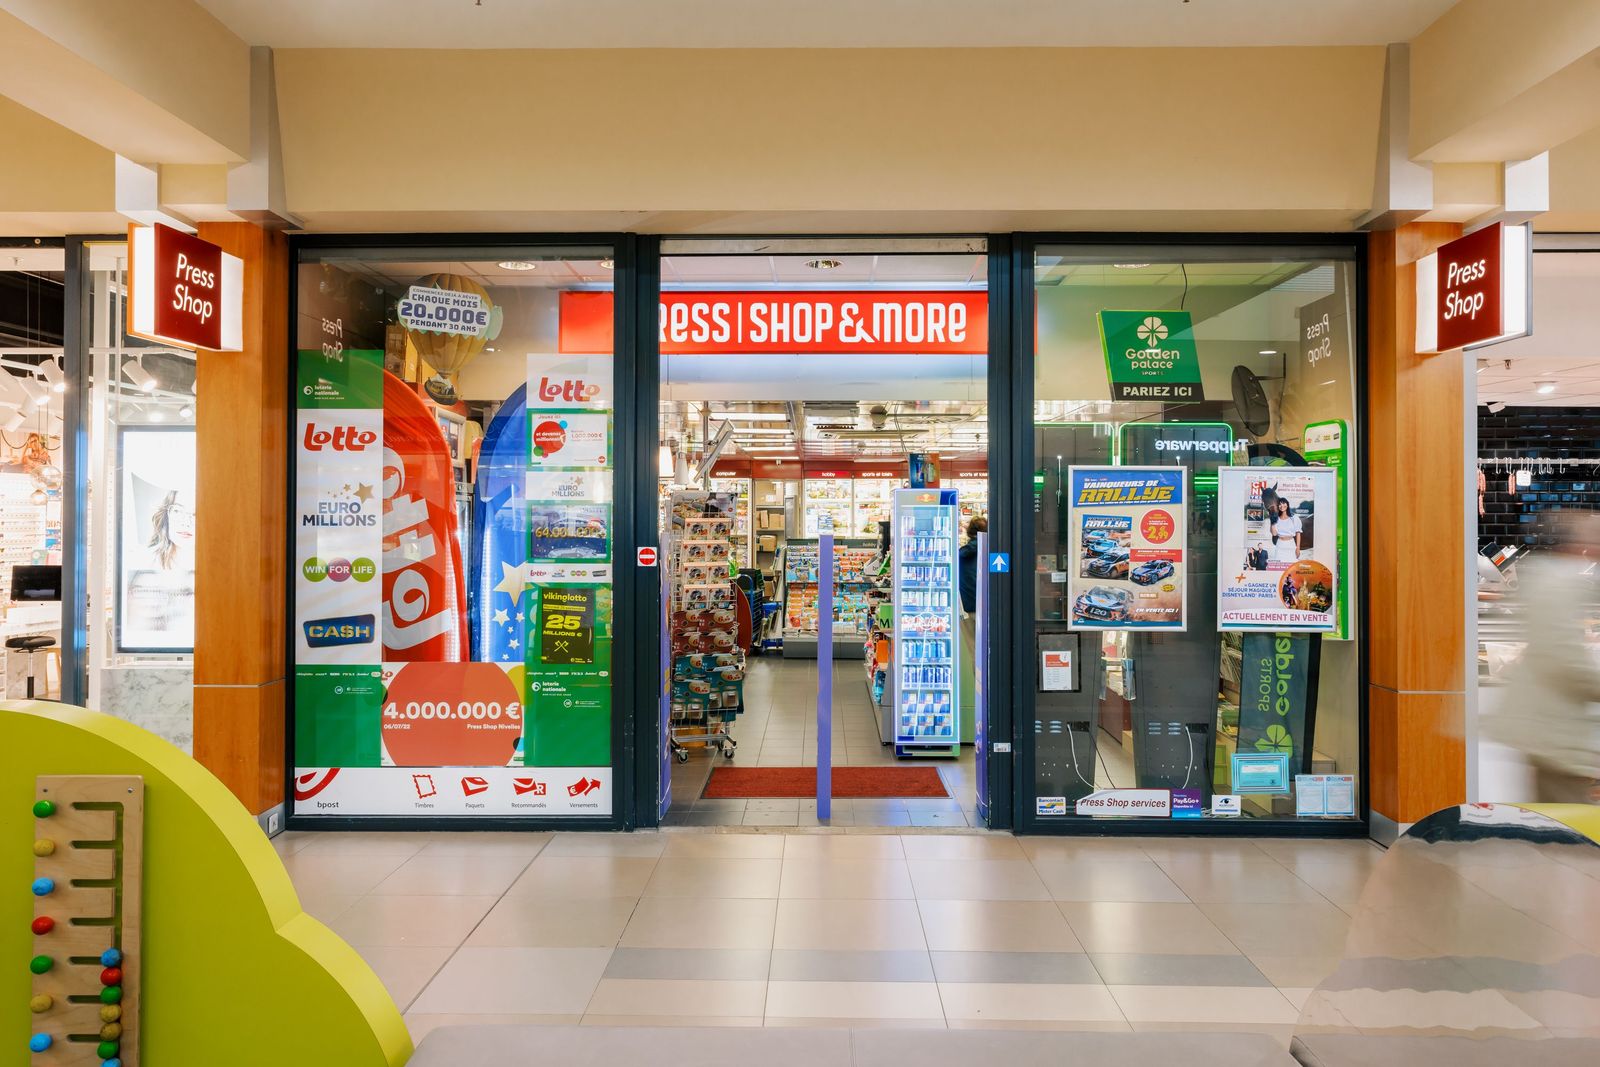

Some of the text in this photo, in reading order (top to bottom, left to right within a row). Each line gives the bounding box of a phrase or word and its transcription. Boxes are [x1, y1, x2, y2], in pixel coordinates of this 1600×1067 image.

[176, 253, 215, 289] Press
[1447, 259, 1486, 289] Press
[173, 284, 213, 325] Shop
[412, 294, 478, 308] CHAQUE MOIS
[1444, 291, 1484, 320] Shop
[401, 301, 487, 325] 20.000€
[410, 319, 447, 329] PENDANT
[460, 325, 477, 333] ANS
[1131, 360, 1173, 370] palace
[1123, 386, 1192, 396] PARIEZ ICI
[1083, 480, 1145, 489] VAINQUEURS
[1078, 486, 1176, 503] RALLYE
[318, 501, 361, 514] EURO
[302, 514, 377, 527] MILLIONS
[305, 565, 373, 574] WIN FOR LIFE
[543, 592, 588, 602] vikinglotto
[545, 614, 582, 630] 25
[1223, 612, 1328, 622] ACTUELLEMENT EN VENTE
[384, 701, 520, 719] 4.000.000 €
[483, 723, 498, 731] Shop
[317, 801, 339, 810] bpost
[465, 802, 485, 810] Paquets
[1080, 798, 1167, 809] Press Shop services
